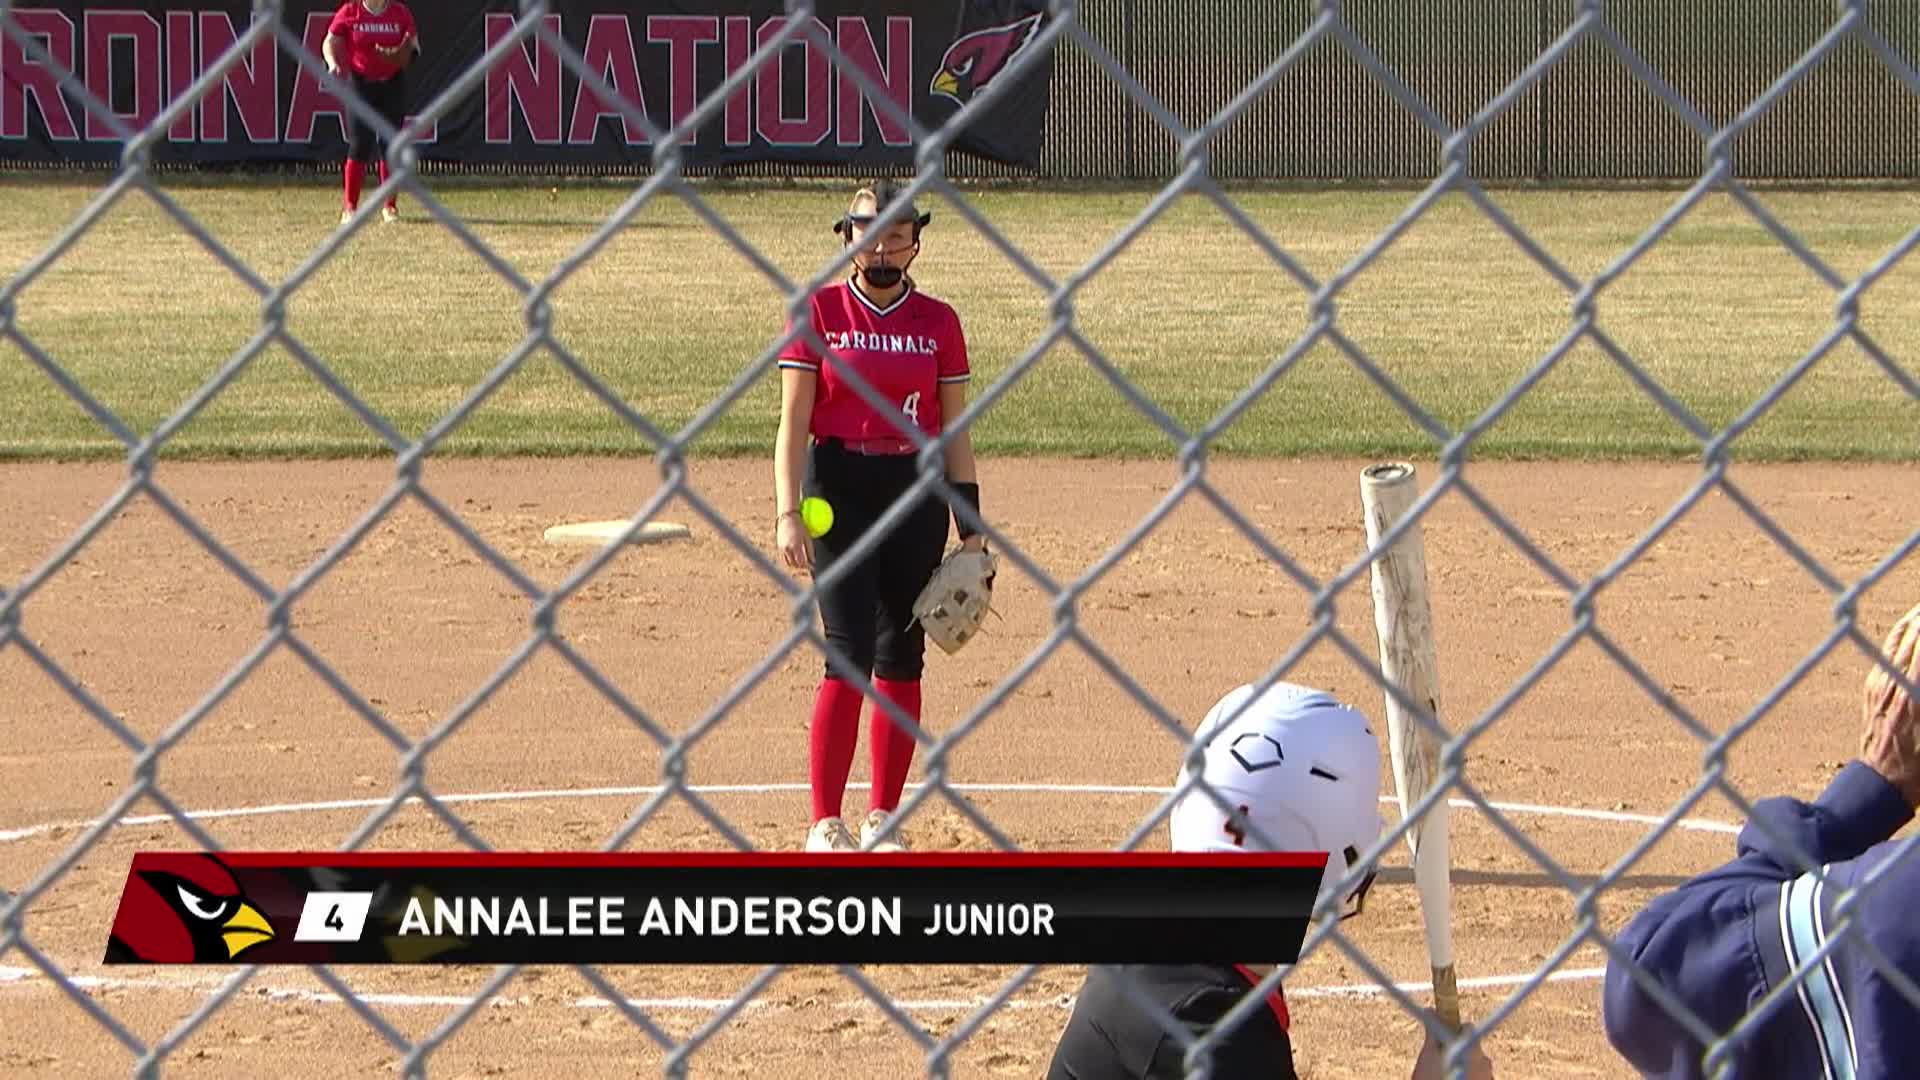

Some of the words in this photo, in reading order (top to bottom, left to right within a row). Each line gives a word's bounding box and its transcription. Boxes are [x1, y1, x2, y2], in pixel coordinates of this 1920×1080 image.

[352, 23, 401, 33] CARDINALS
[0, 9, 438, 142] RDINA
[485, 14, 913, 147] NATION
[825, 330, 938, 355] CARDINALS
[902, 391, 921, 427] 4
